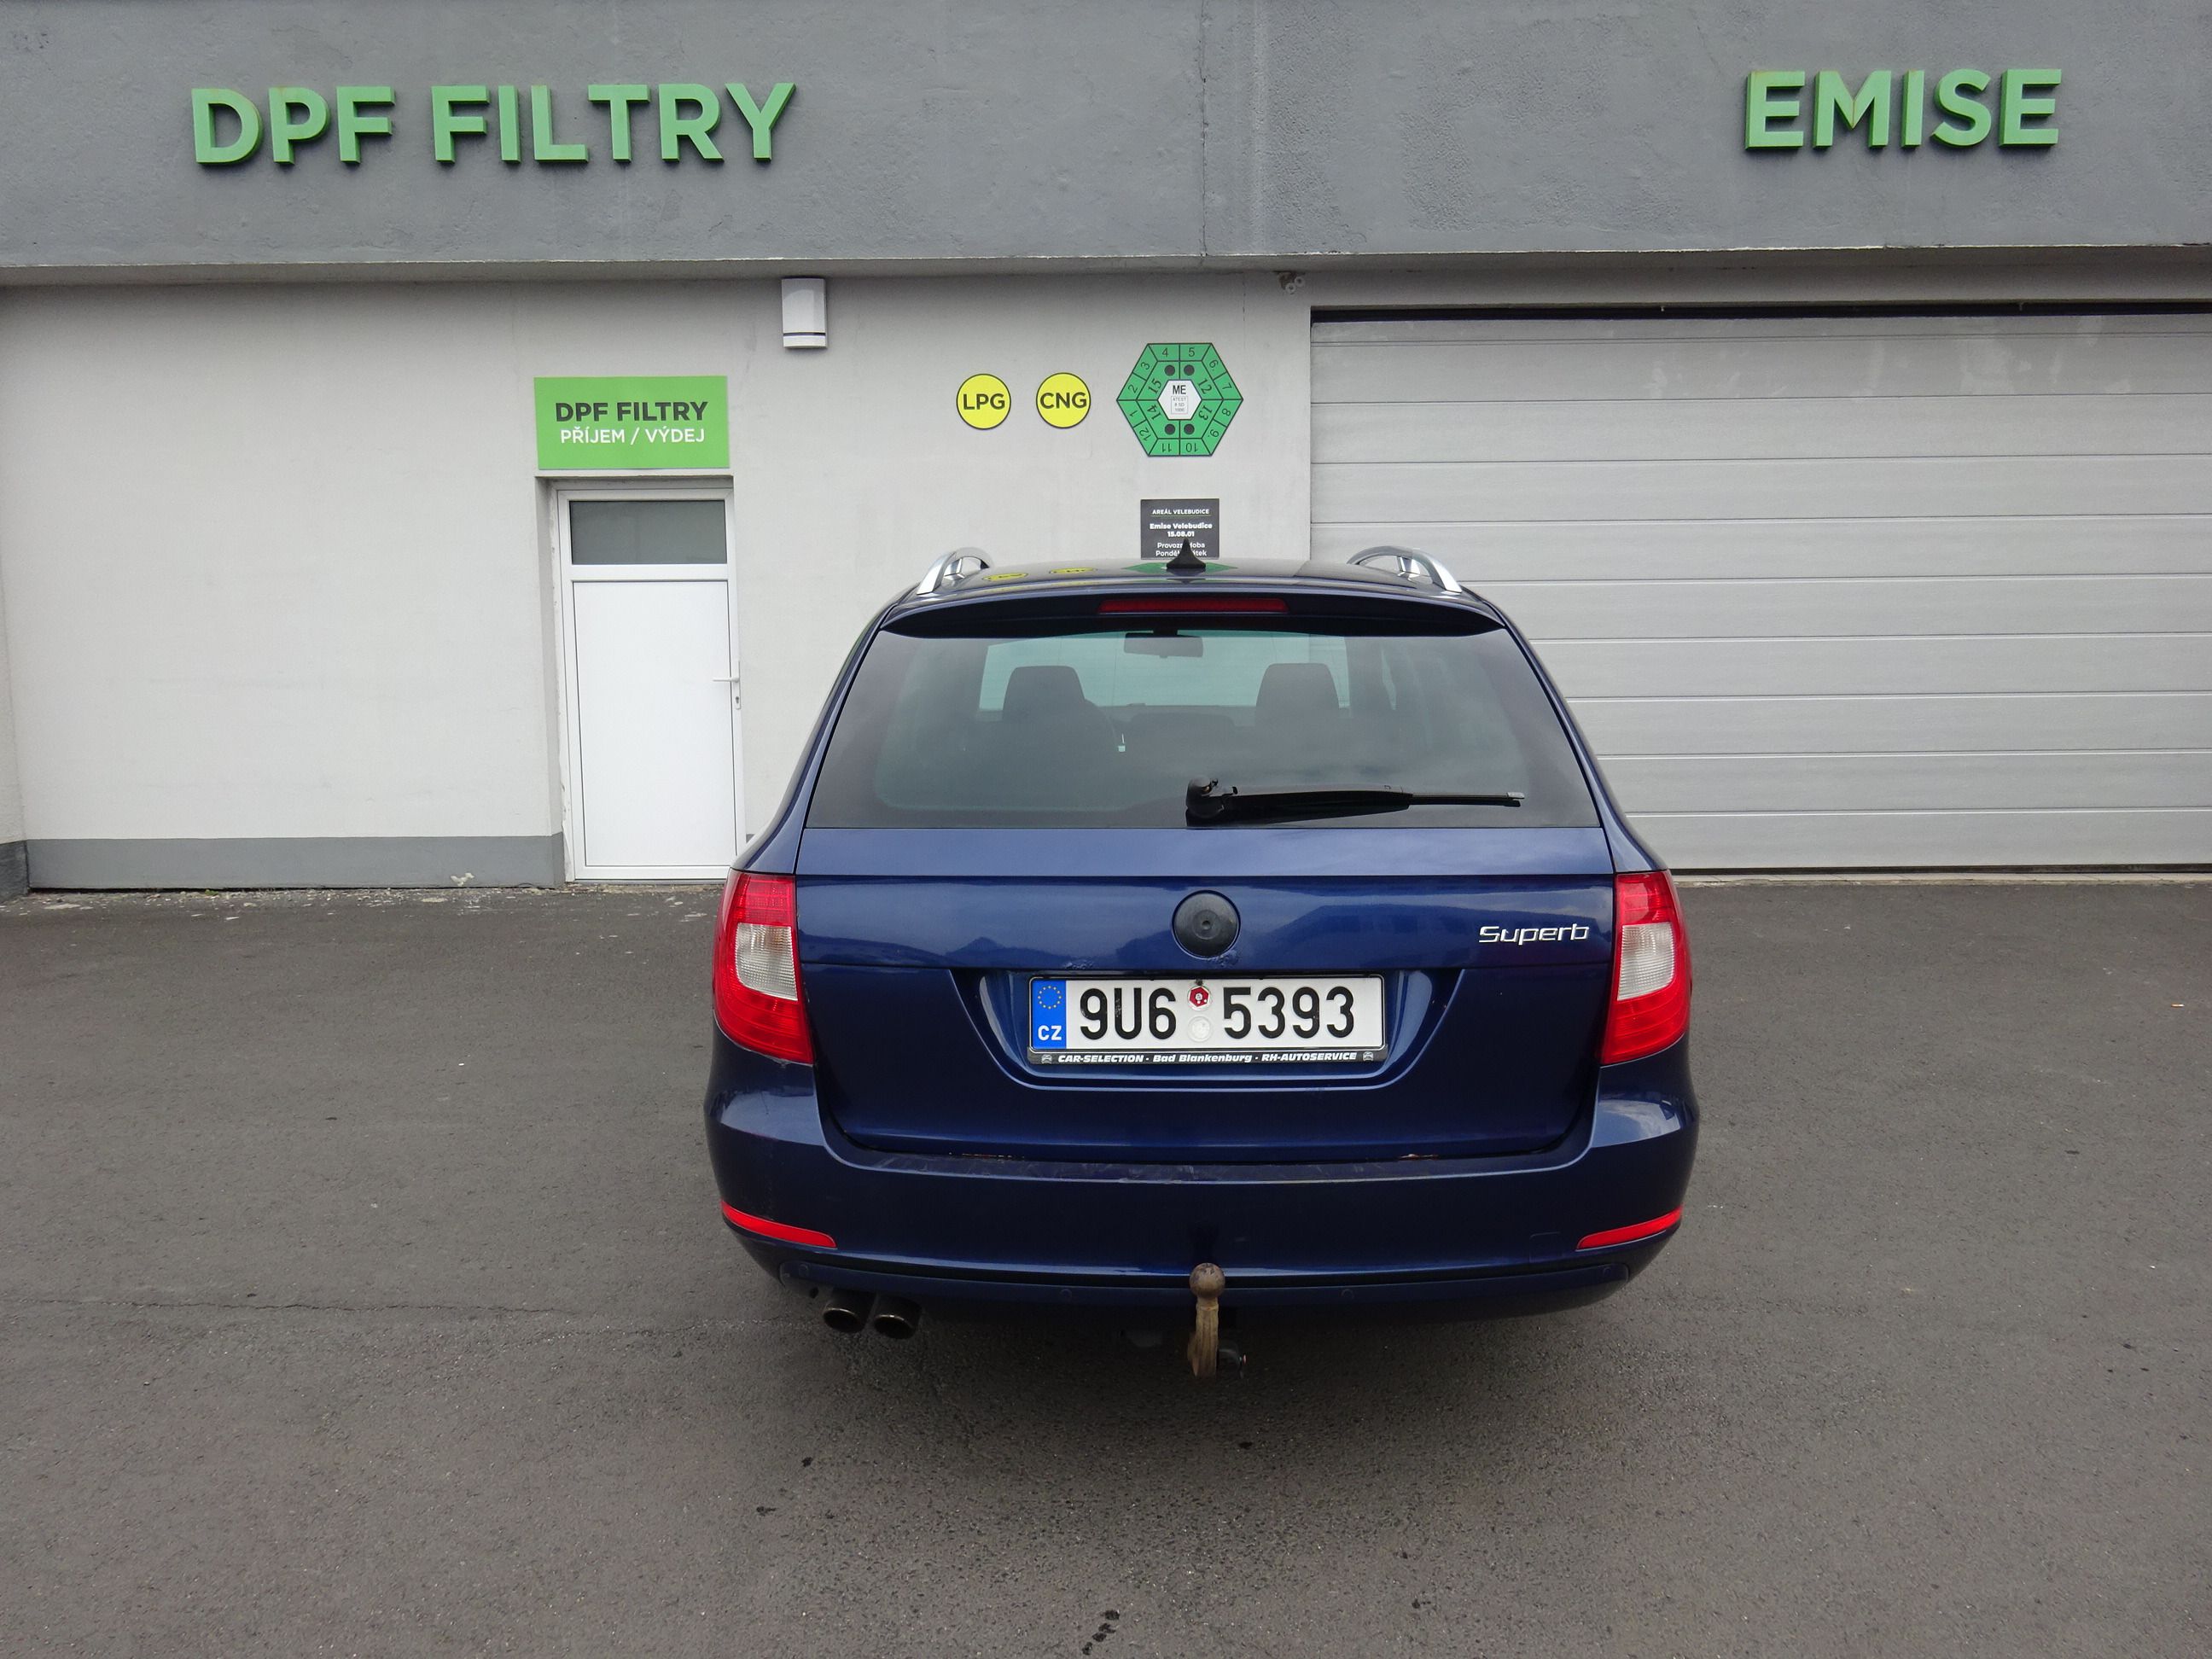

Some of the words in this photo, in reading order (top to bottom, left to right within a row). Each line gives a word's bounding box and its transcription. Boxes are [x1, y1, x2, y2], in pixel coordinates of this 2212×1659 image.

[1744, 68, 2062, 149] EMISE
[190, 85, 395, 165] DPF
[431, 83, 796, 163] FILTRY
[1161, 347, 1168, 357] 4
[1188, 347, 1196, 357] 5
[1140, 361, 1150, 370] 3
[1128, 384, 1138, 393] 2
[1148, 378, 1161, 395] 15
[1173, 385, 1186, 394] ME
[1196, 378, 1213, 394] 12
[963, 393, 1005, 410] LPG
[1039, 392, 1087, 409] CNG
[555, 402, 608, 422] DPF
[616, 401, 708, 421] FILTRY
[1146, 405, 1161, 420] 14
[1198, 405, 1213, 421] 13
[1221, 408, 1231, 416] 8
[560, 426, 626, 444] PŘÍJEM
[644, 426, 705, 443] VÝDEJ
[1139, 427, 1151, 440] 12
[1161, 443, 1173, 451] 11
[1185, 442, 1198, 452] 10
[1479, 923, 1590, 946] Superb
[1080, 987, 1177, 1039] 9U6
[1223, 986, 1354, 1039] 5393
[1038, 1025, 1062, 1041] CZ
[1152, 1054, 1176, 1062] Bad
[1179, 1054, 1252, 1063] Blankenburg
[1261, 1052, 1357, 1061] RH-AUTOSERVICE
